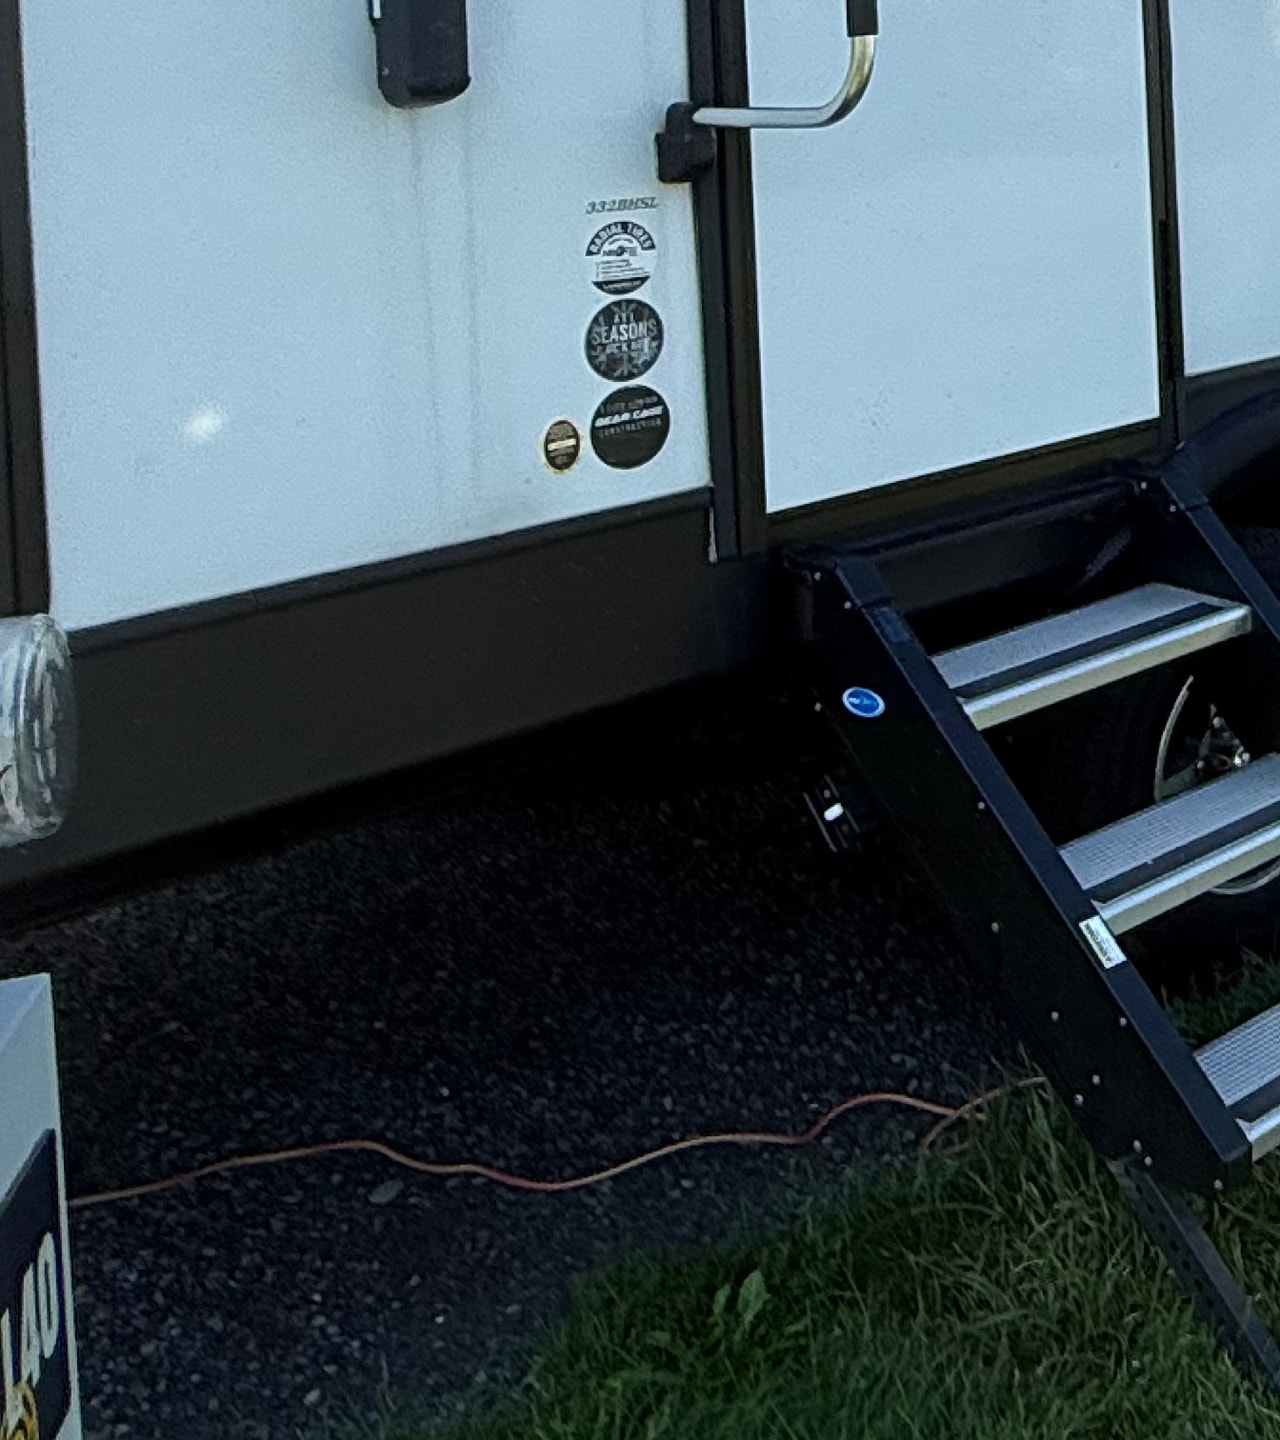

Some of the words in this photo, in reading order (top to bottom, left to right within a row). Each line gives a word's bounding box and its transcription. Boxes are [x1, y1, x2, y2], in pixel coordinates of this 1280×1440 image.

[589, 223, 625, 253] RADIAL
[626, 223, 653, 249] TIRES
[591, 318, 658, 345] SEASONS
